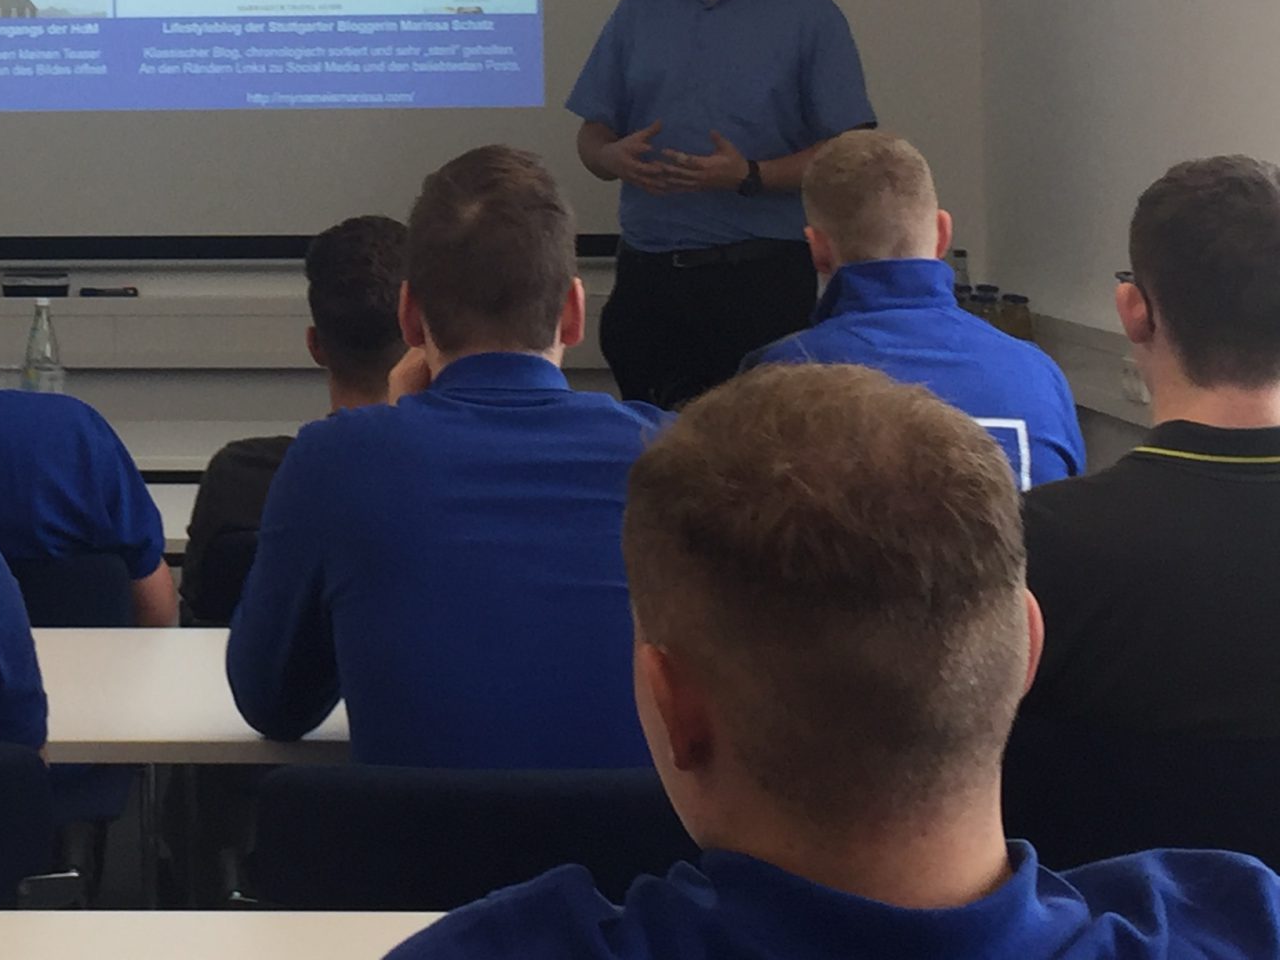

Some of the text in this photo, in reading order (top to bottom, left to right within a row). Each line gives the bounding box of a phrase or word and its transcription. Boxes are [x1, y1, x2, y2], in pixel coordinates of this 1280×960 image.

[47, 23, 68, 35] der
[162, 22, 242, 35] Lifestyleblog
[244, 22, 265, 33] der
[268, 21, 334, 35] Stuttgarter
[336, 20, 398, 34] Bloggerin
[400, 20, 450, 32] Marissa
